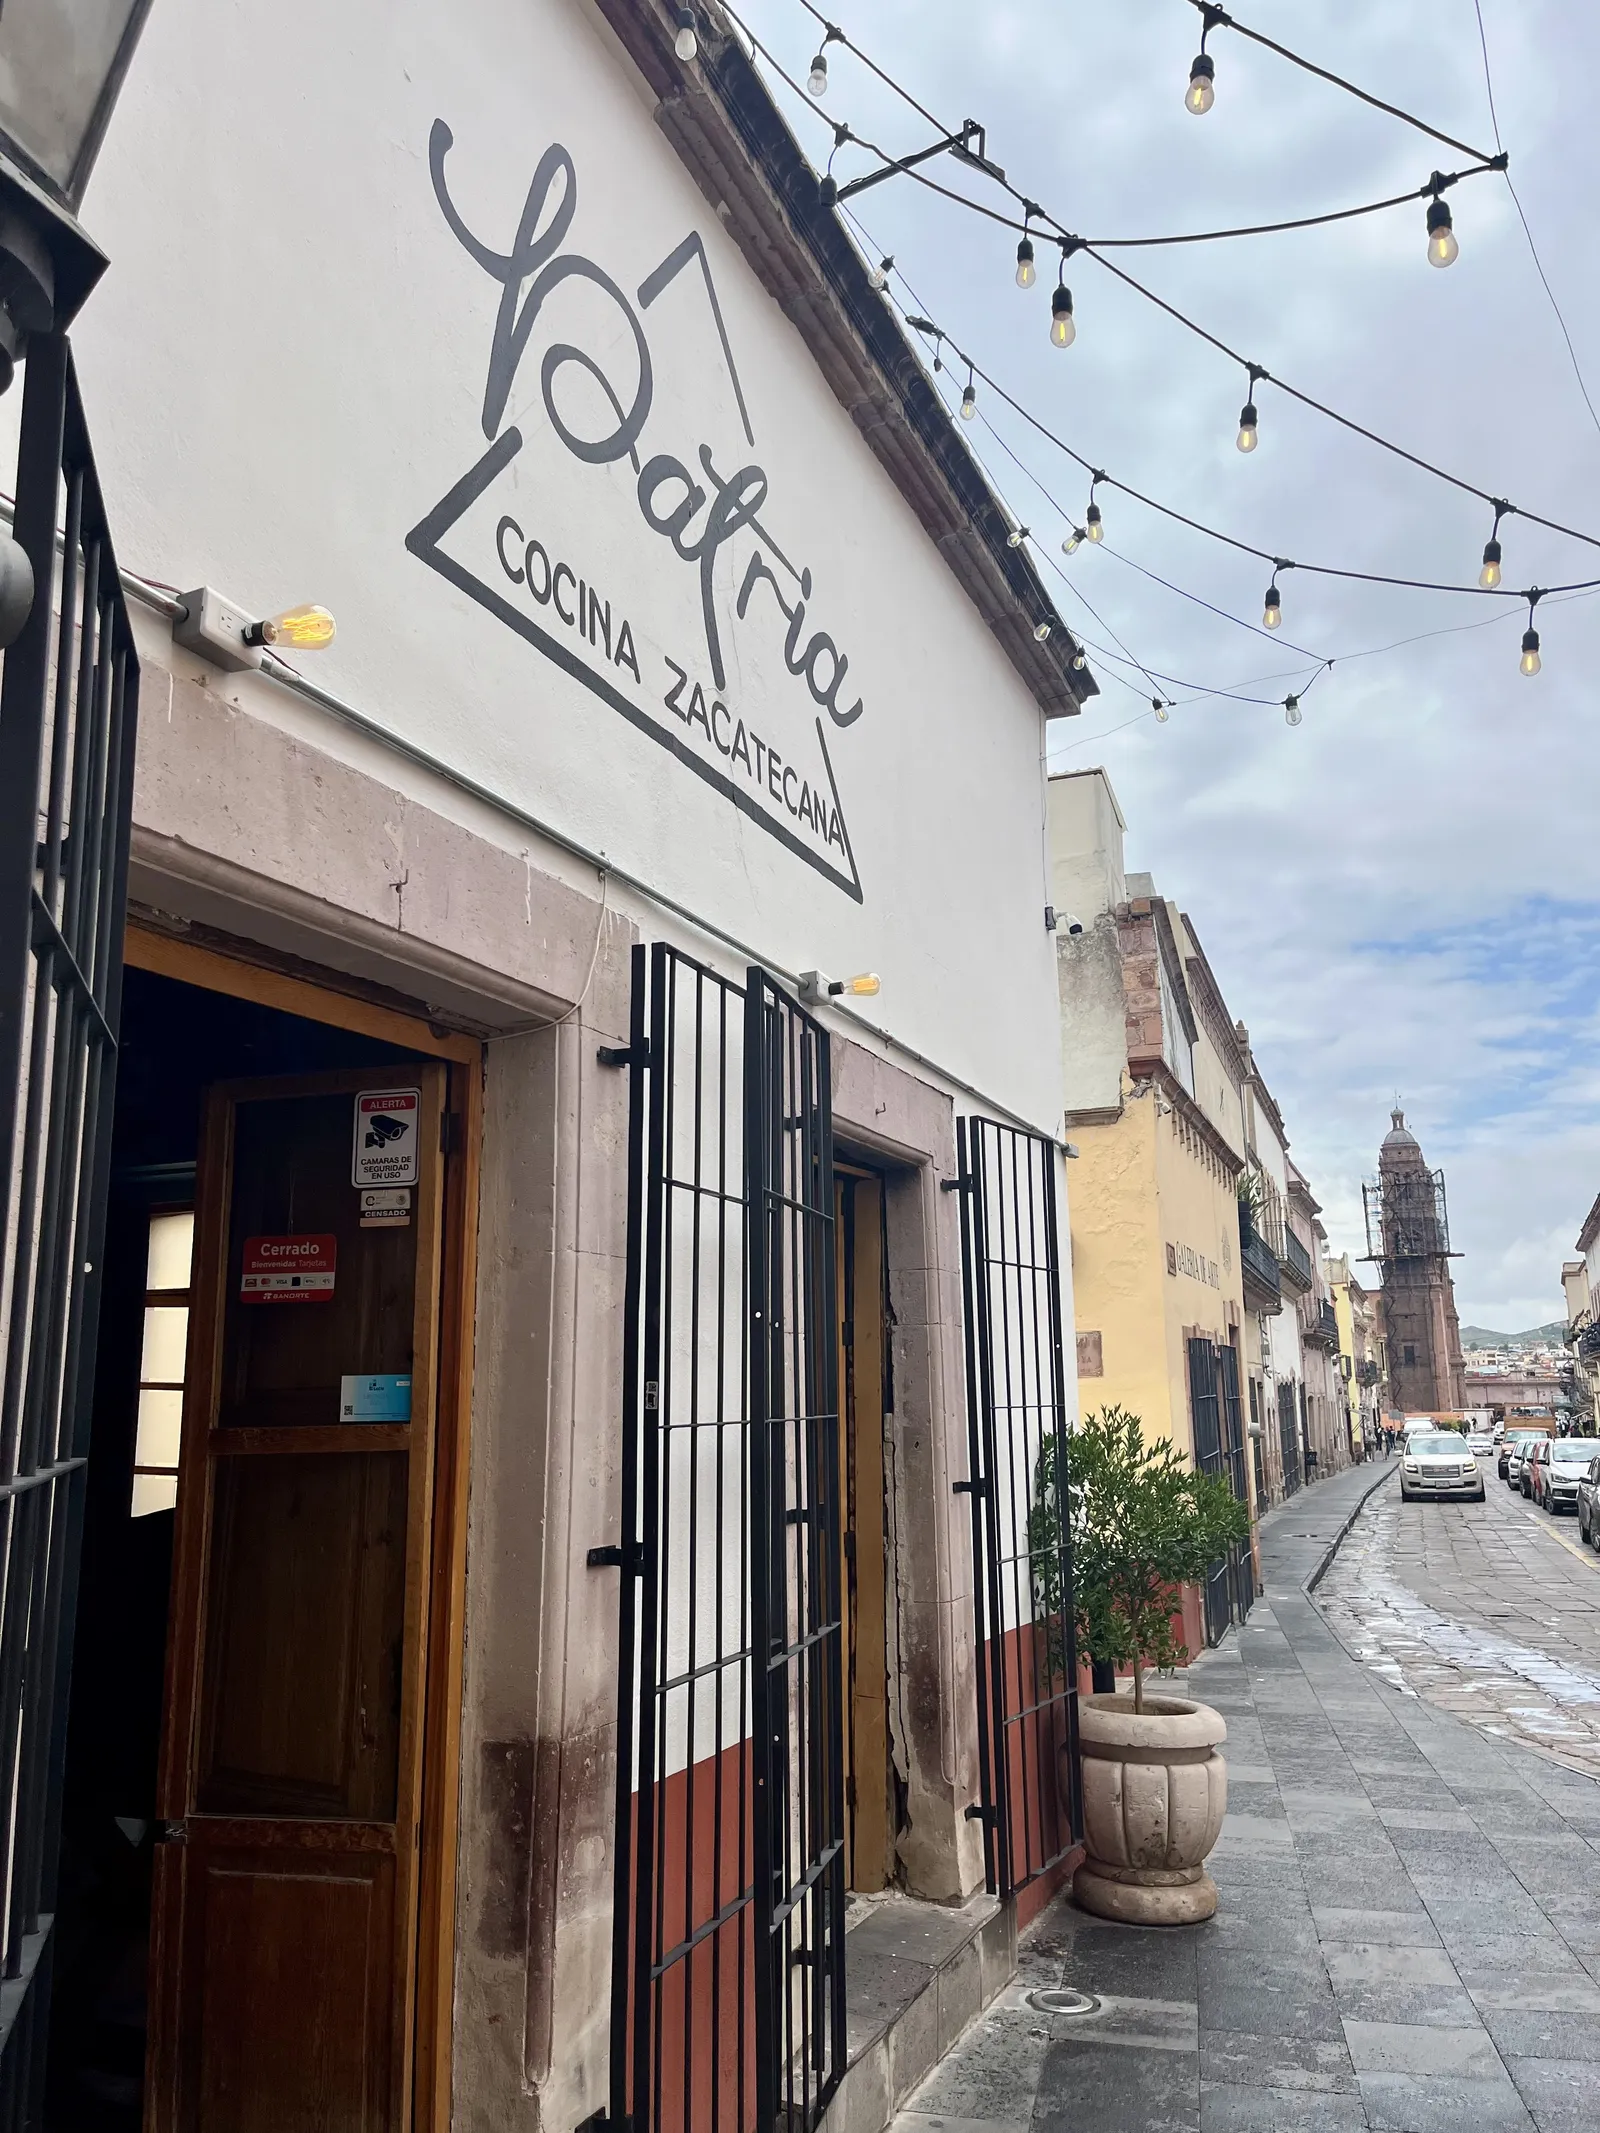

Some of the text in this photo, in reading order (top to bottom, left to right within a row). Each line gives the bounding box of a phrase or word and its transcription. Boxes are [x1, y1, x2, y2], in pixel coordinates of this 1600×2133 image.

[495, 514, 846, 858] COCINA ZACATECANA
[369, 1099, 407, 1109] ALERTA
[360, 1155, 412, 1166] CAMARAS DE
[363, 1163, 409, 1173] SEGURIDAD
[371, 1171, 401, 1180] EN USO
[365, 1210, 406, 1218] CENSADO
[260, 1241, 320, 1256] Cerrado
[251, 1258, 327, 1269] Bienvenidas Tarjetas
